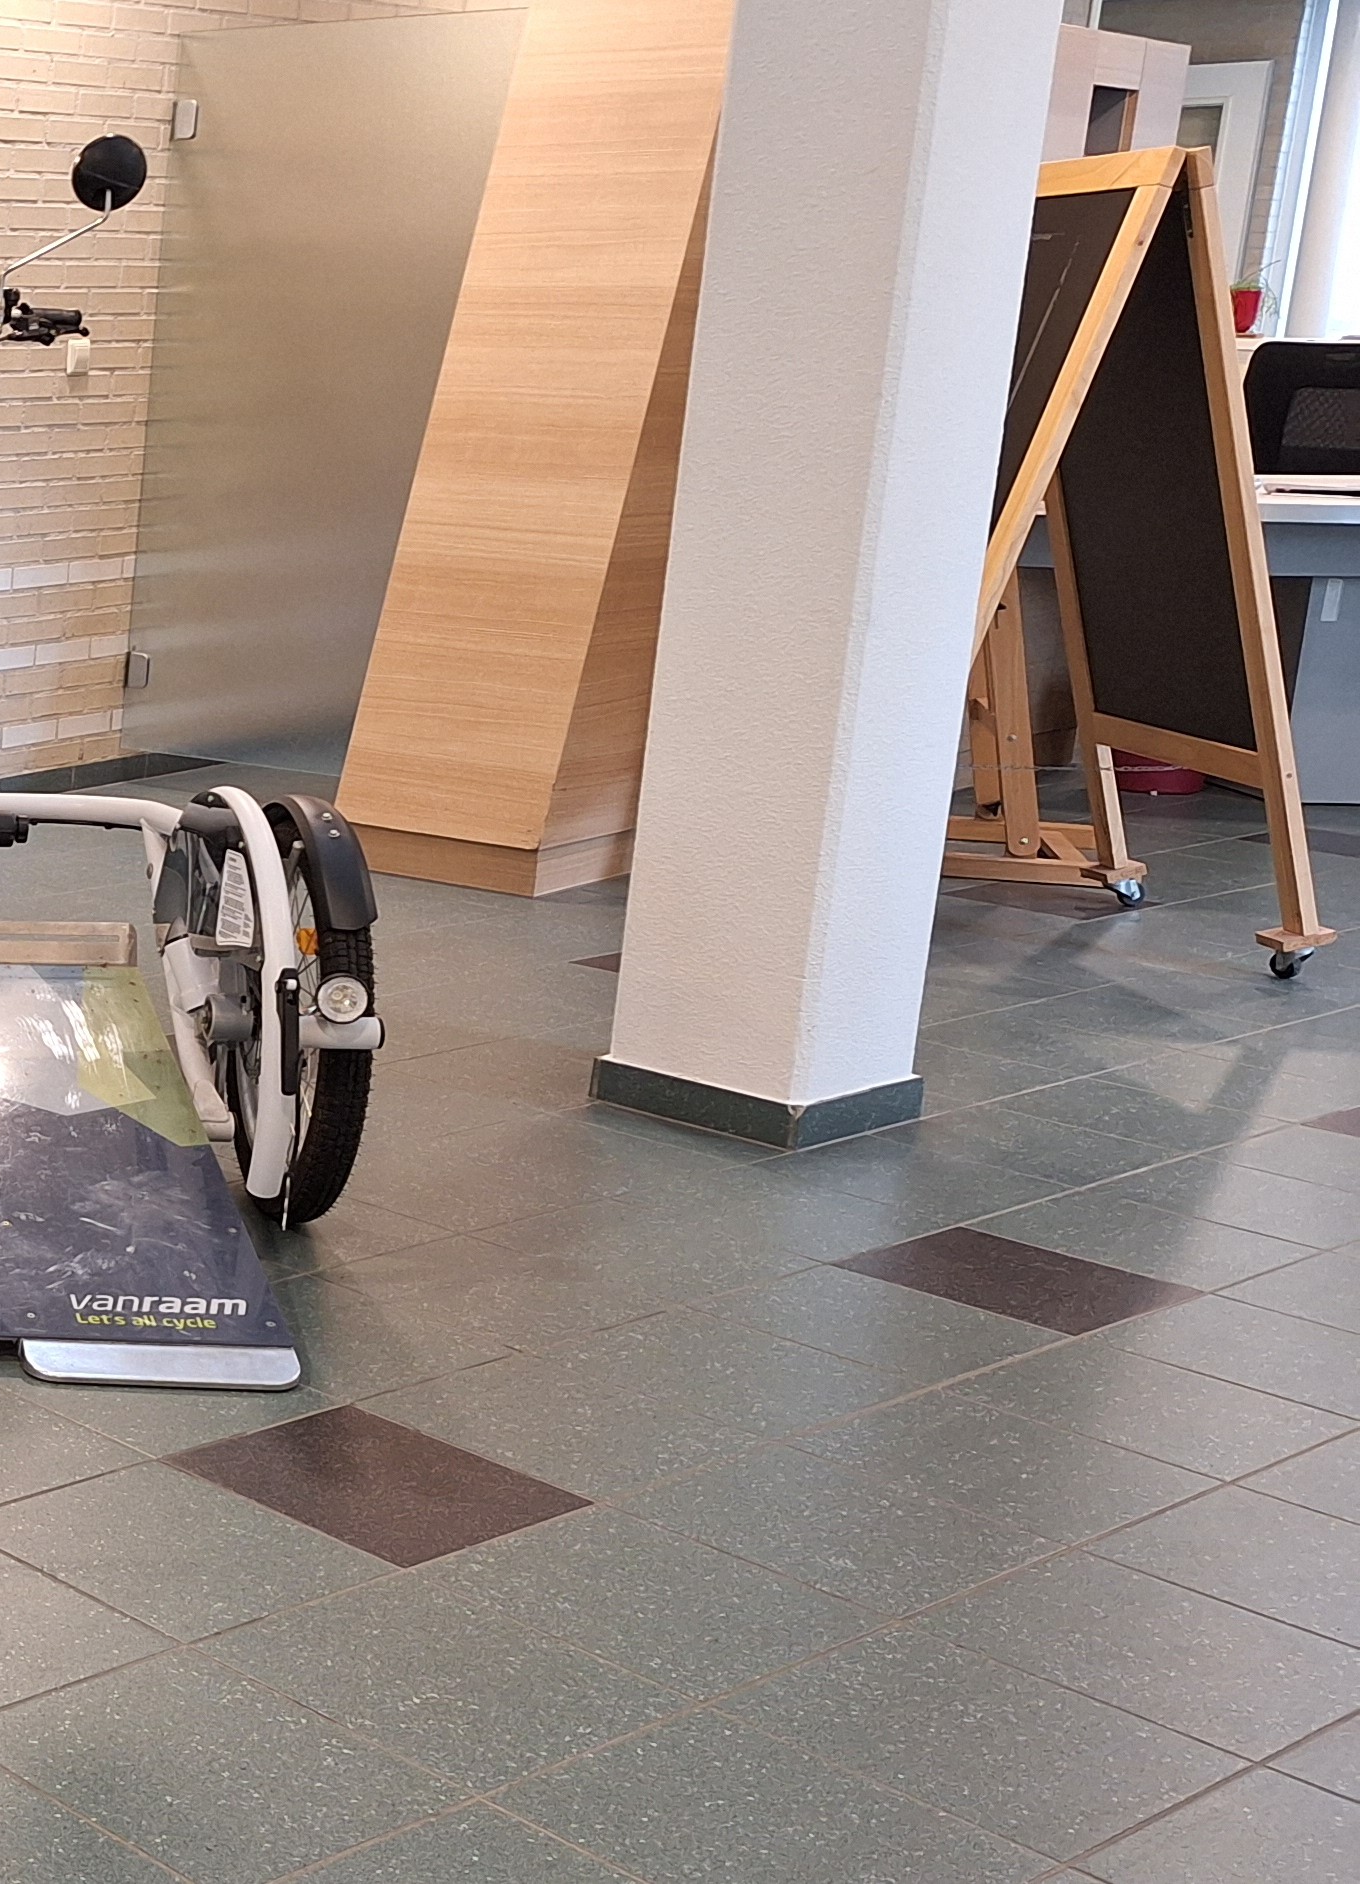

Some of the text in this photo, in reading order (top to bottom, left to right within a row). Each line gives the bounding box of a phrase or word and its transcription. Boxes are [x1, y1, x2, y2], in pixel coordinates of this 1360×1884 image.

[69, 1293, 248, 1316] vanraam
[131, 1315, 158, 1327] all
[162, 1316, 217, 1330] cycle
